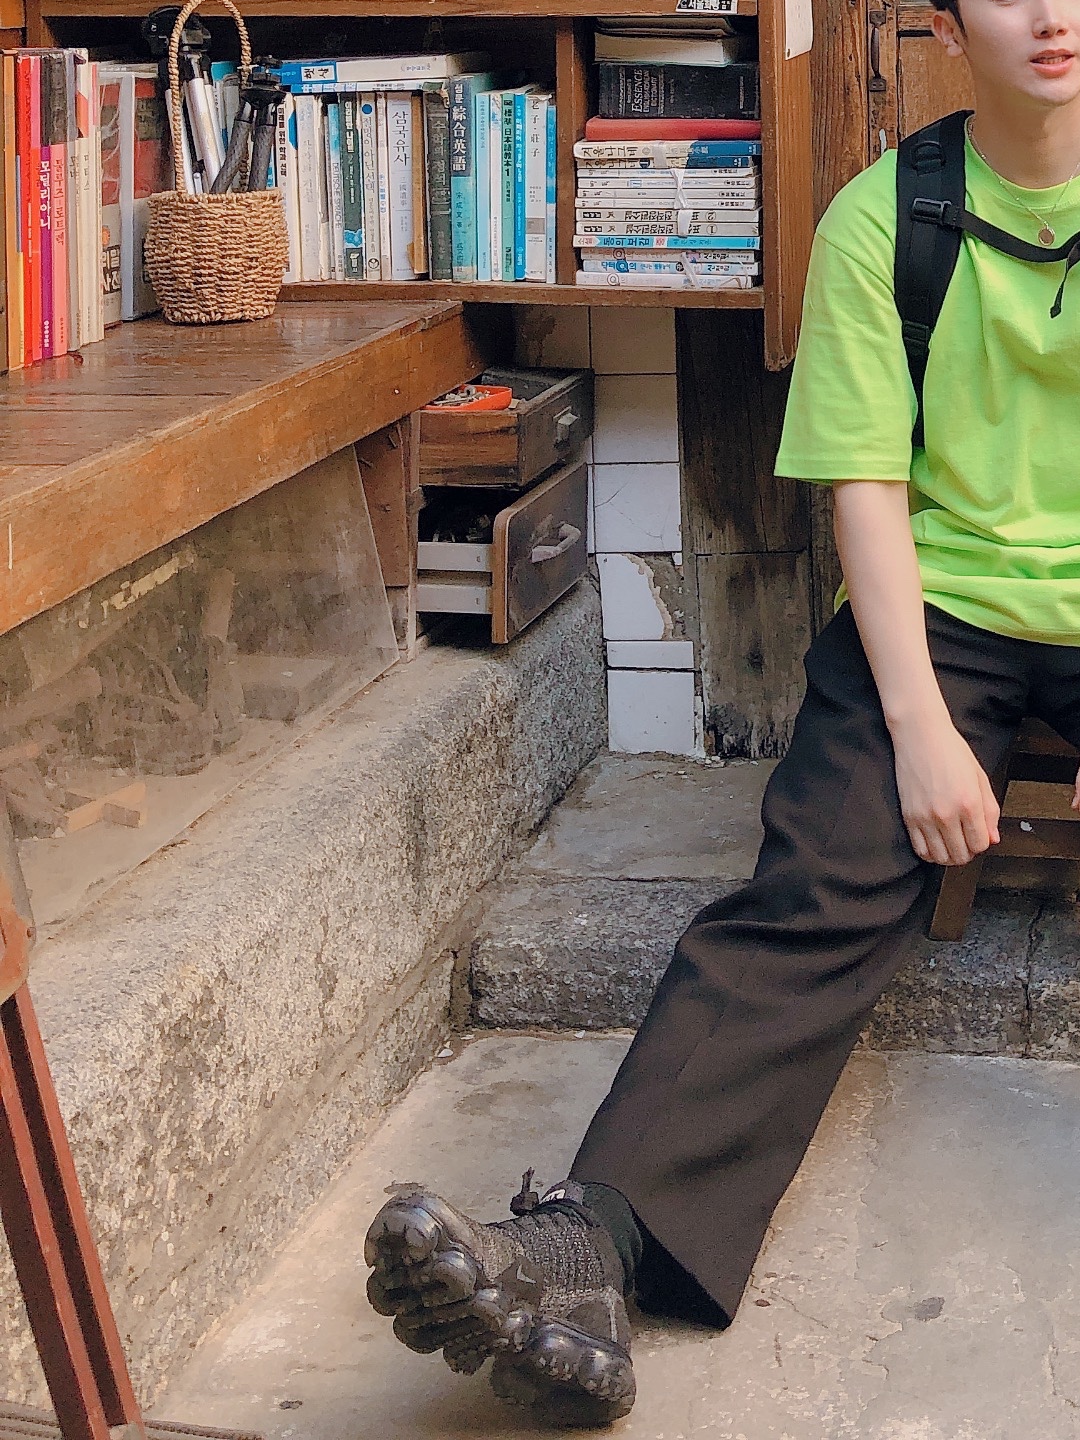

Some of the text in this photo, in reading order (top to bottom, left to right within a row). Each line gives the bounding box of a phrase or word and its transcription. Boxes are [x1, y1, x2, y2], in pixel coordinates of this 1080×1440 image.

[631, 69, 643, 113] ESSENCE
[391, 110, 410, 167] 삼국유사
[452, 105, 467, 171] 綜合英語
[40, 160, 52, 229] 모딜리아니
[603, 237, 650, 247] 동의보감
